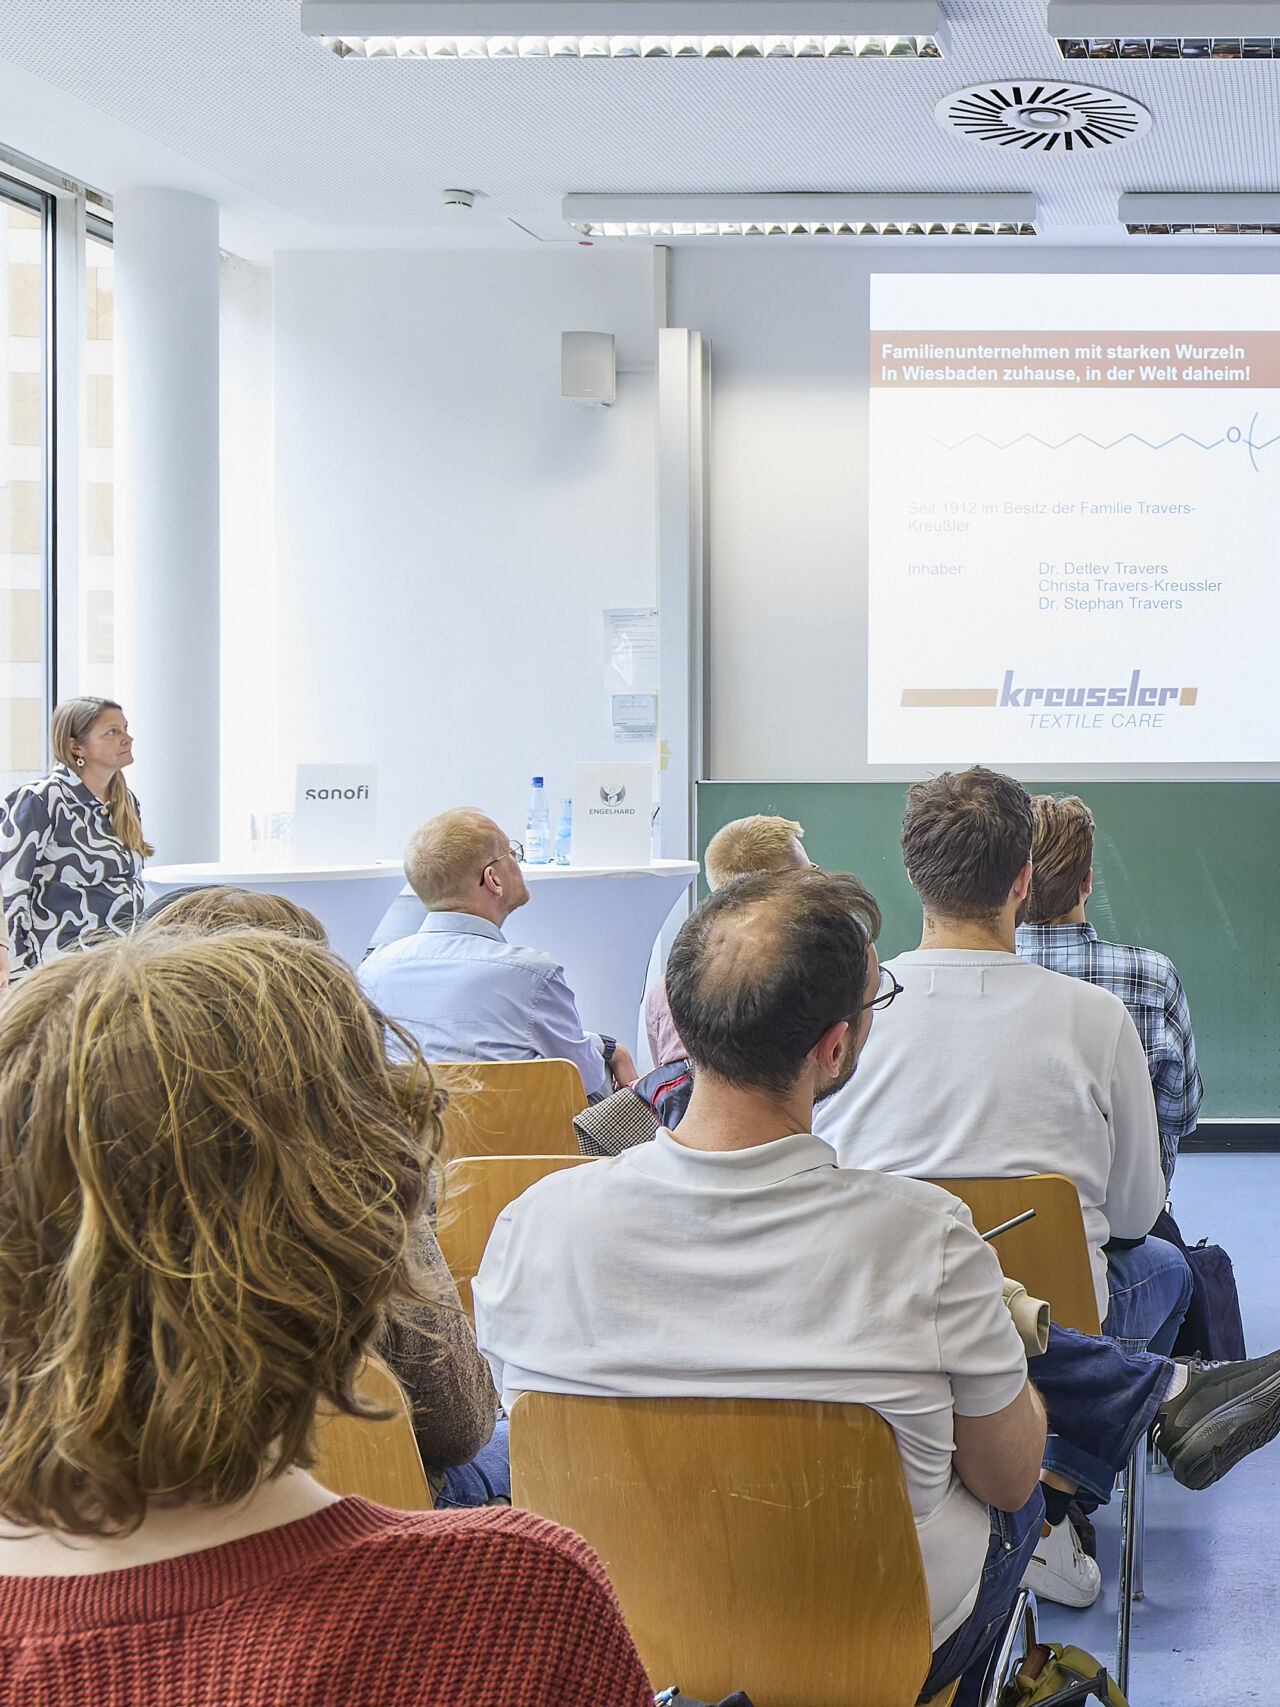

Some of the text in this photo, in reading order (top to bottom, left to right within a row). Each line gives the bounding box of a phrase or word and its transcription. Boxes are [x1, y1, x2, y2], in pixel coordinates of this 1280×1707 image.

[881, 343, 1245, 360] Familienunternehmen mit starken Wurzeln
[881, 365, 1251, 384] In Wiesbaden zuhause, in der Welt daheim!
[907, 501, 1197, 514] Seit 1912 im Besitz der Familie Travers-
[907, 519, 971, 532] Kreußler
[907, 561, 967, 576] Inhaber:
[1038, 561, 1169, 575] Dr. Detlev Travers
[1038, 579, 1223, 592] Christa Travers-Kreussler
[1038, 596, 1183, 613] Dr. Stephan Travers
[999, 669, 1178, 708] kreussler
[1028, 713, 1165, 729] TEXTILE CARE
[305, 784, 369, 800] sanofi
